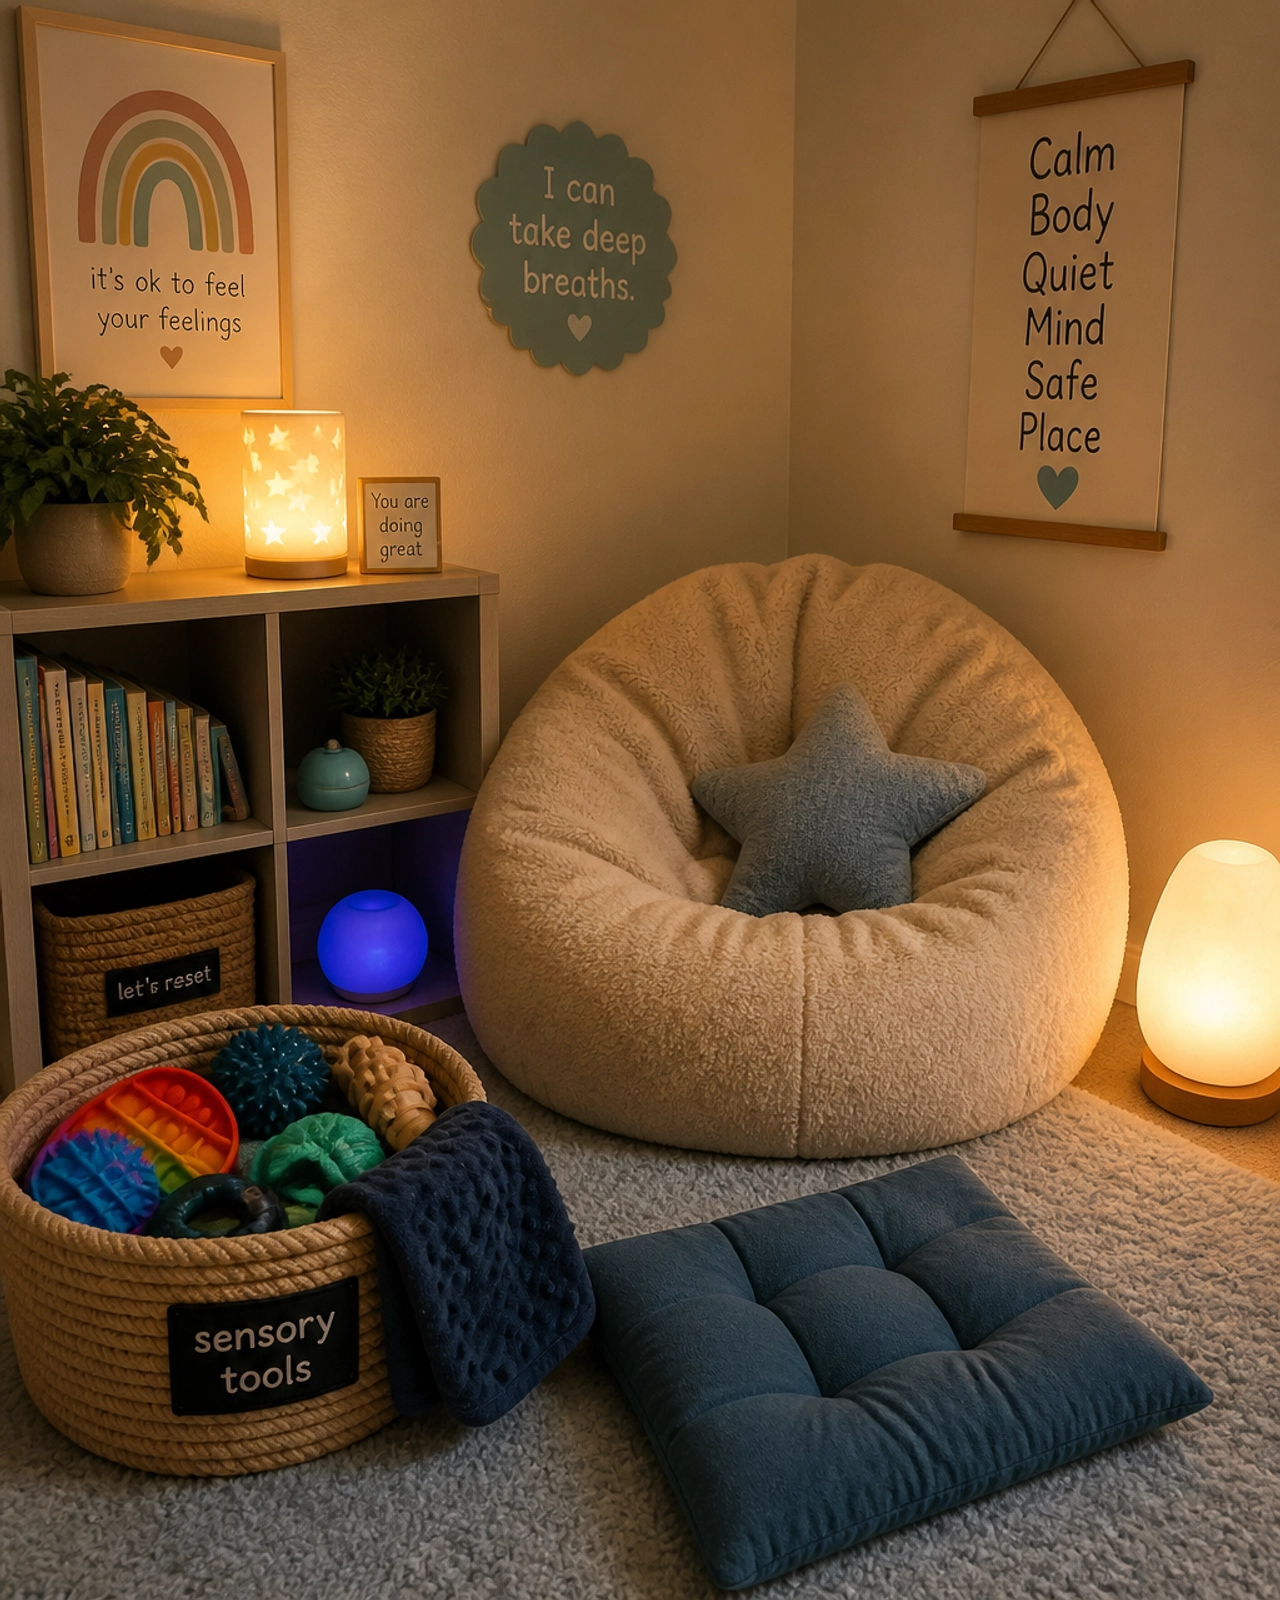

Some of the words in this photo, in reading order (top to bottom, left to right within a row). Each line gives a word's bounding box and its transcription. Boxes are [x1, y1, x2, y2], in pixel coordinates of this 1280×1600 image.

[1029, 131, 1115, 180] Calm
[544, 165, 554, 199] I
[567, 179, 615, 206] can
[1029, 187, 1114, 245] Body
[509, 213, 571, 249] take
[582, 219, 646, 265] deep
[90, 266, 125, 291] it's
[135, 268, 161, 293] ok
[171, 272, 194, 295] to
[204, 271, 246, 298] feel
[524, 260, 635, 301] breaths.
[1022, 251, 1114, 296] Quiet
[97, 312, 149, 336] your
[158, 306, 242, 341] feelings
[1025, 302, 1105, 346] Mind
[1025, 358, 1098, 401] Safe
[1019, 411, 1100, 454] Place
[371, 492, 398, 509] You
[404, 497, 429, 509] are
[379, 516, 423, 538] doing
[380, 541, 423, 563] great
[118, 976, 159, 1000] let's
[165, 965, 211, 991] reset
[194, 1311, 335, 1353] sensory
[220, 1354, 312, 1394] tools
